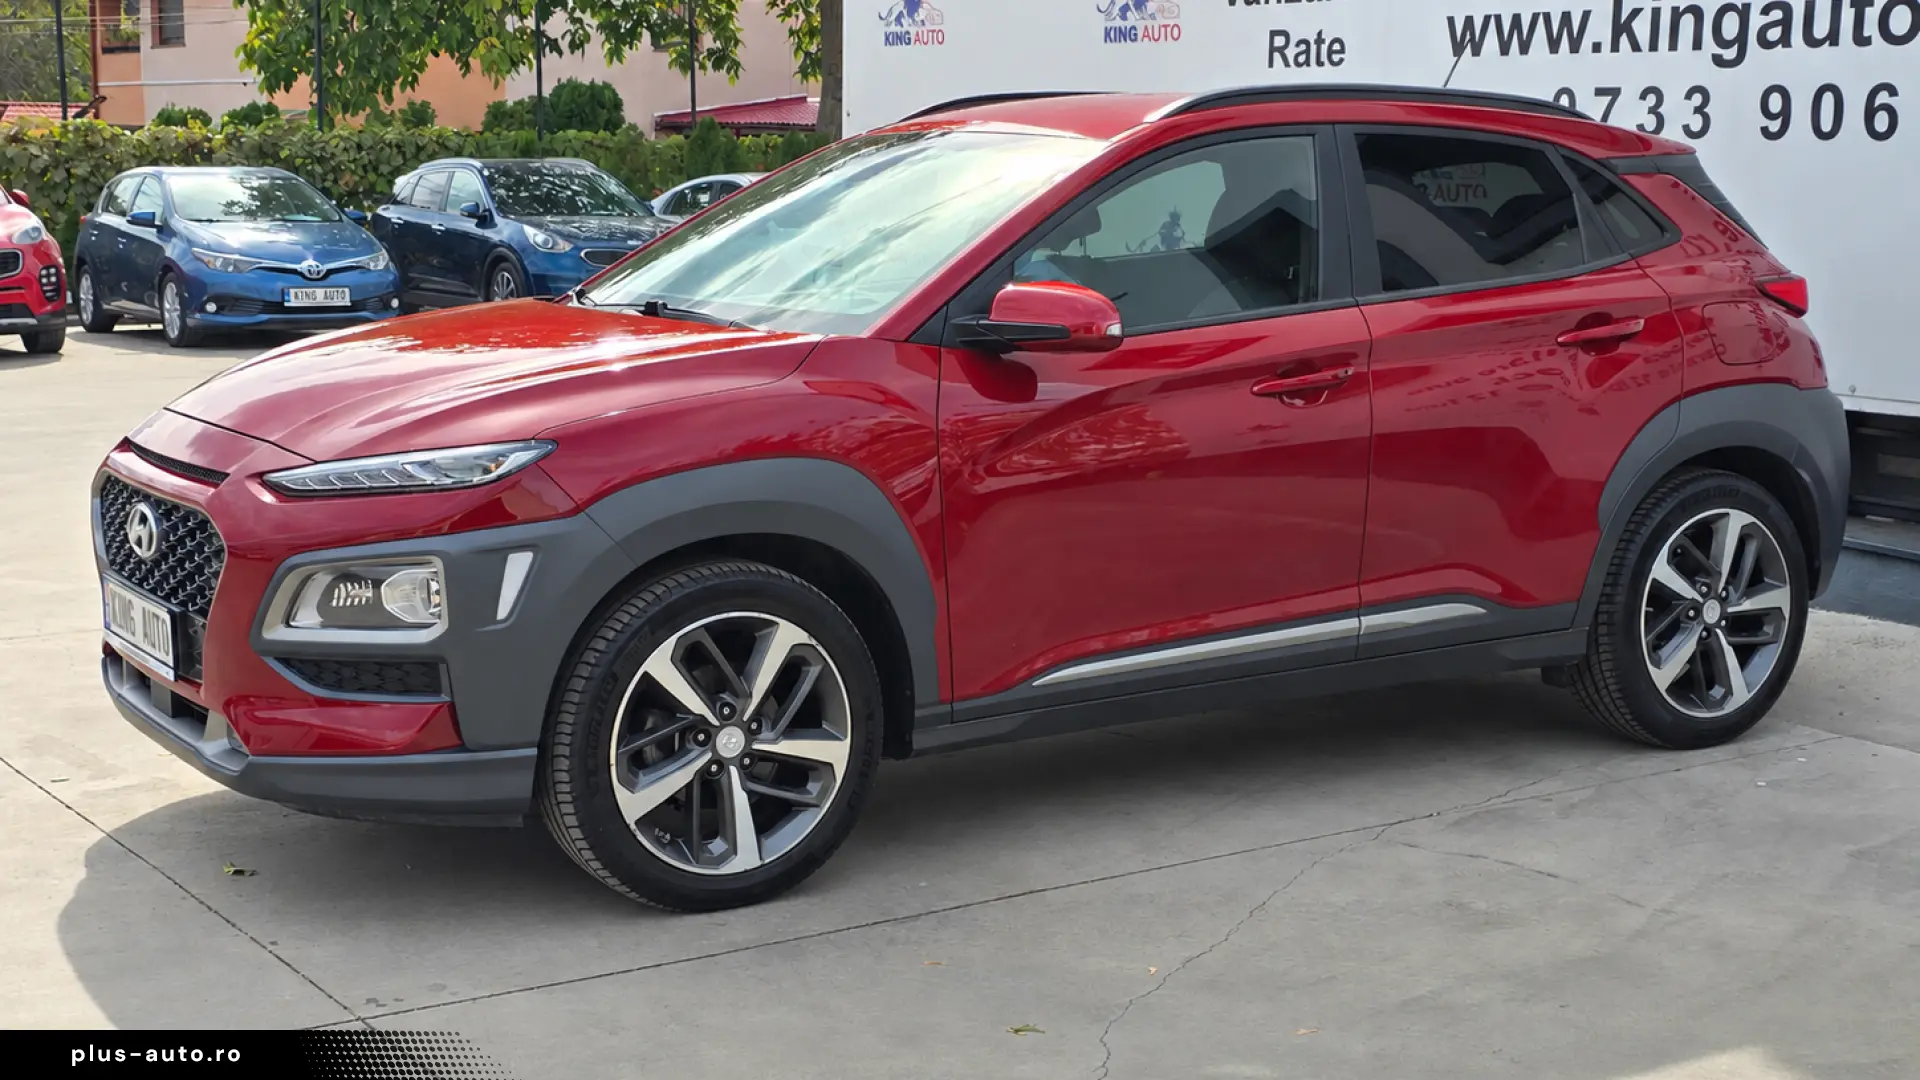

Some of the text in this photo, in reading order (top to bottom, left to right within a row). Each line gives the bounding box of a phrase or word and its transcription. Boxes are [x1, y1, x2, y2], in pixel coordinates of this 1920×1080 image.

[884, 29, 945, 47] KING AUTO
[1104, 23, 1181, 44] KING AUTO
[1268, 29, 1346, 68] Rate
[293, 289, 346, 301] KING AUTO
[109, 587, 169, 657] KING AUTO
